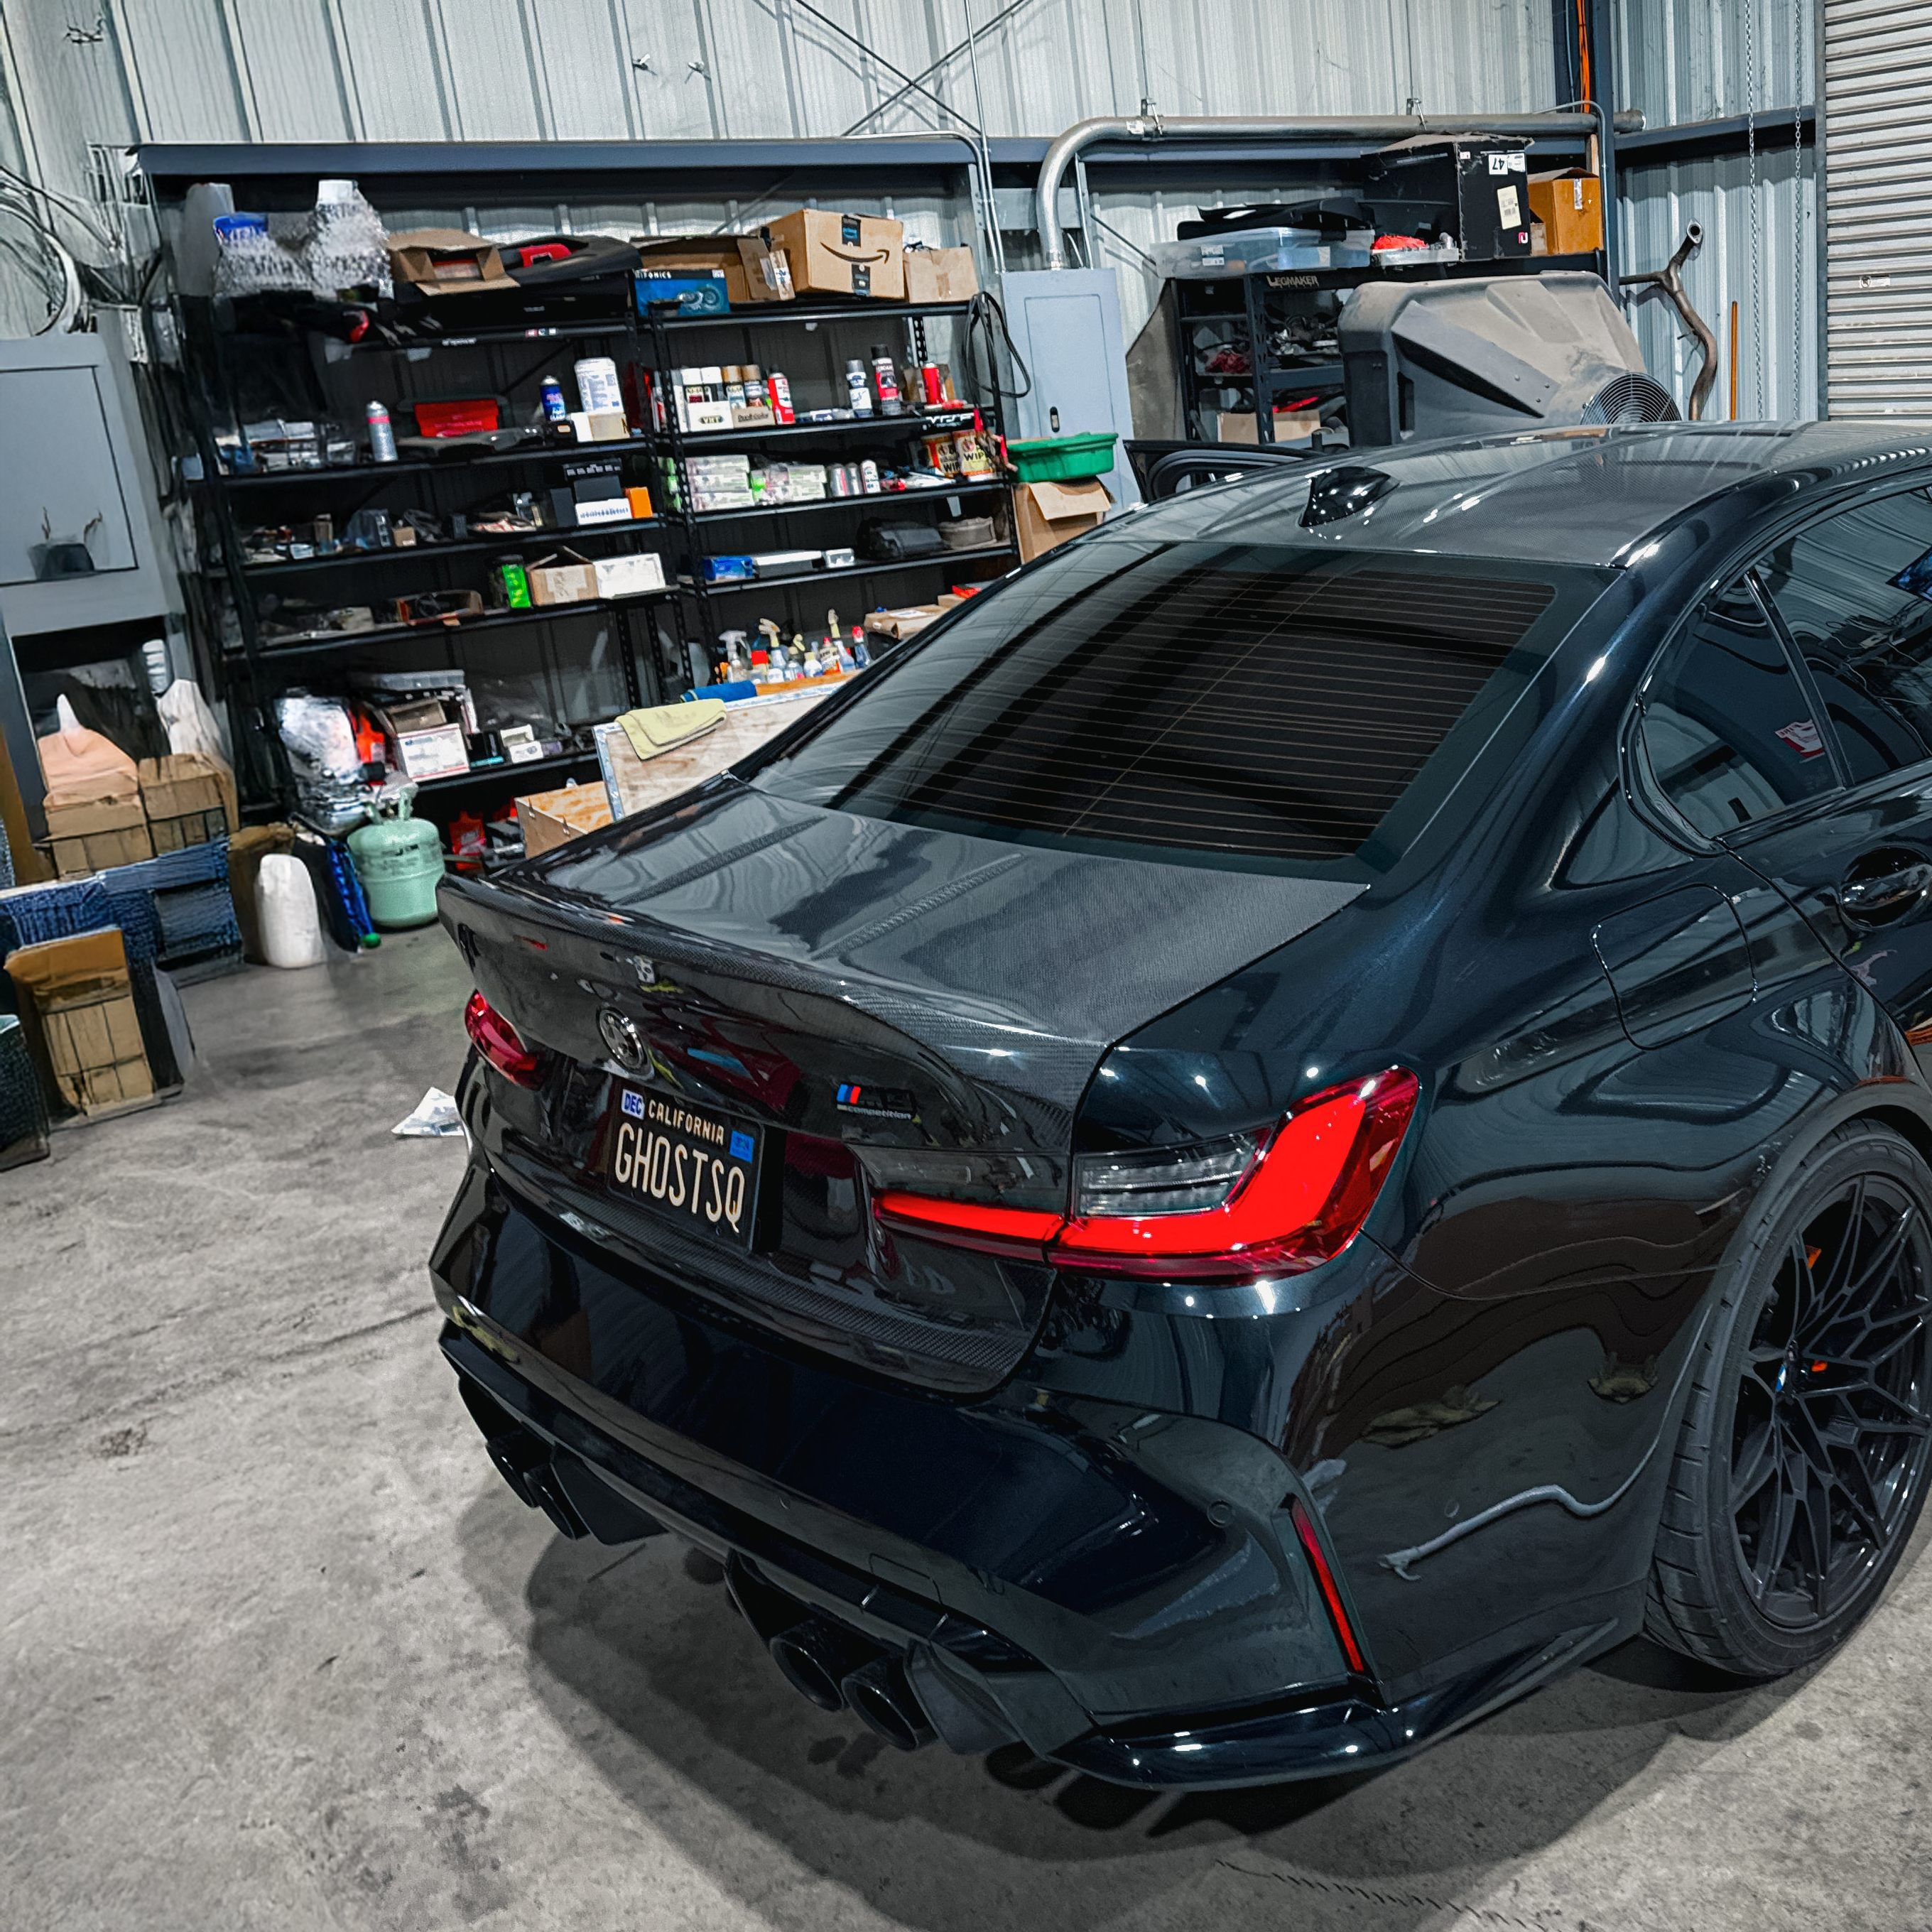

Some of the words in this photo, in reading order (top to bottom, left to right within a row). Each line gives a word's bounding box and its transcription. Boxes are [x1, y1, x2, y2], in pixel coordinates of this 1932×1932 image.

[1492, 157, 1505, 170] 47
[624, 1092, 643, 1117] DEC
[847, 1106, 912, 1120] competition
[648, 1100, 724, 1146] CALIFORNIA
[615, 1122, 745, 1234] GHOSTSQ
